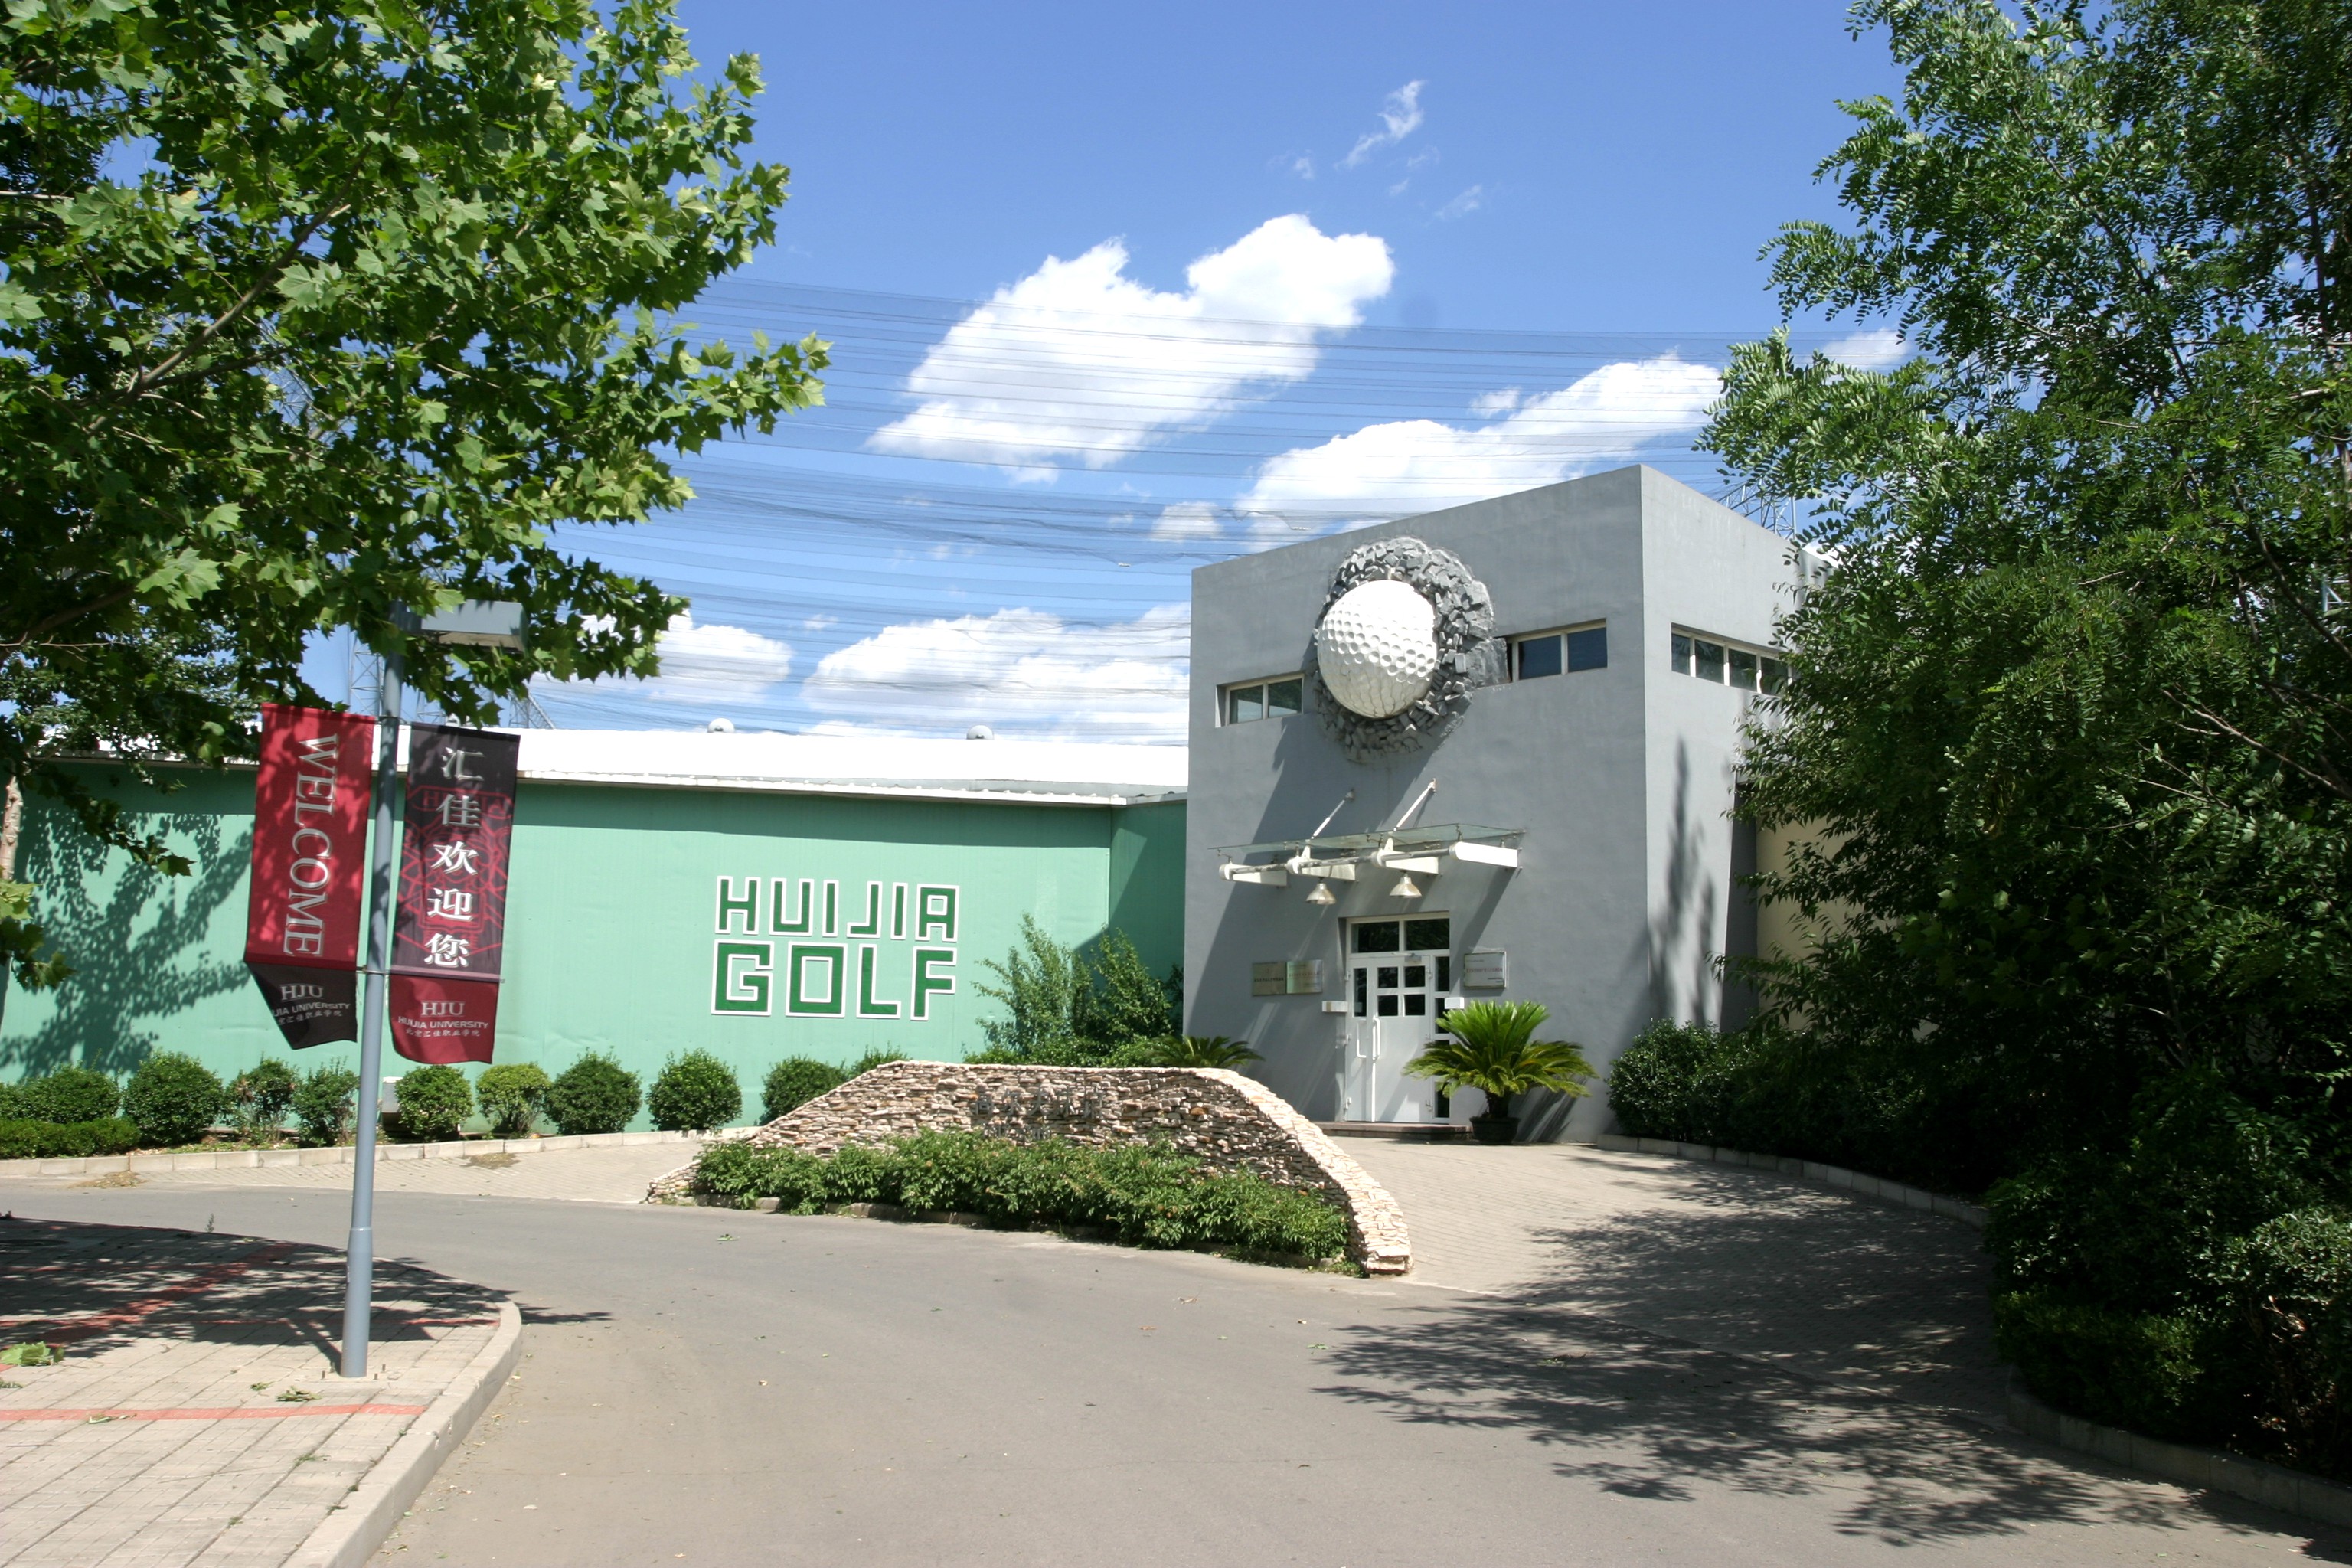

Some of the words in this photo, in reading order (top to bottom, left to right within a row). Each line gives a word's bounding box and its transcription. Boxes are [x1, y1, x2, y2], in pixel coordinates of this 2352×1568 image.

[284, 733, 338, 958] WELCOME
[424, 746, 485, 968] 汇佳欢迎您
[714, 875, 960, 942] HUIJIA
[279, 984, 324, 1001] HJU
[710, 939, 957, 1021] GOLF
[292, 1001, 351, 1014] UNIVERSITY
[398, 1015, 427, 1029] HUIJIA
[430, 1021, 488, 1029] UNIVERSITY
[420, 1001, 465, 1016] HJU
